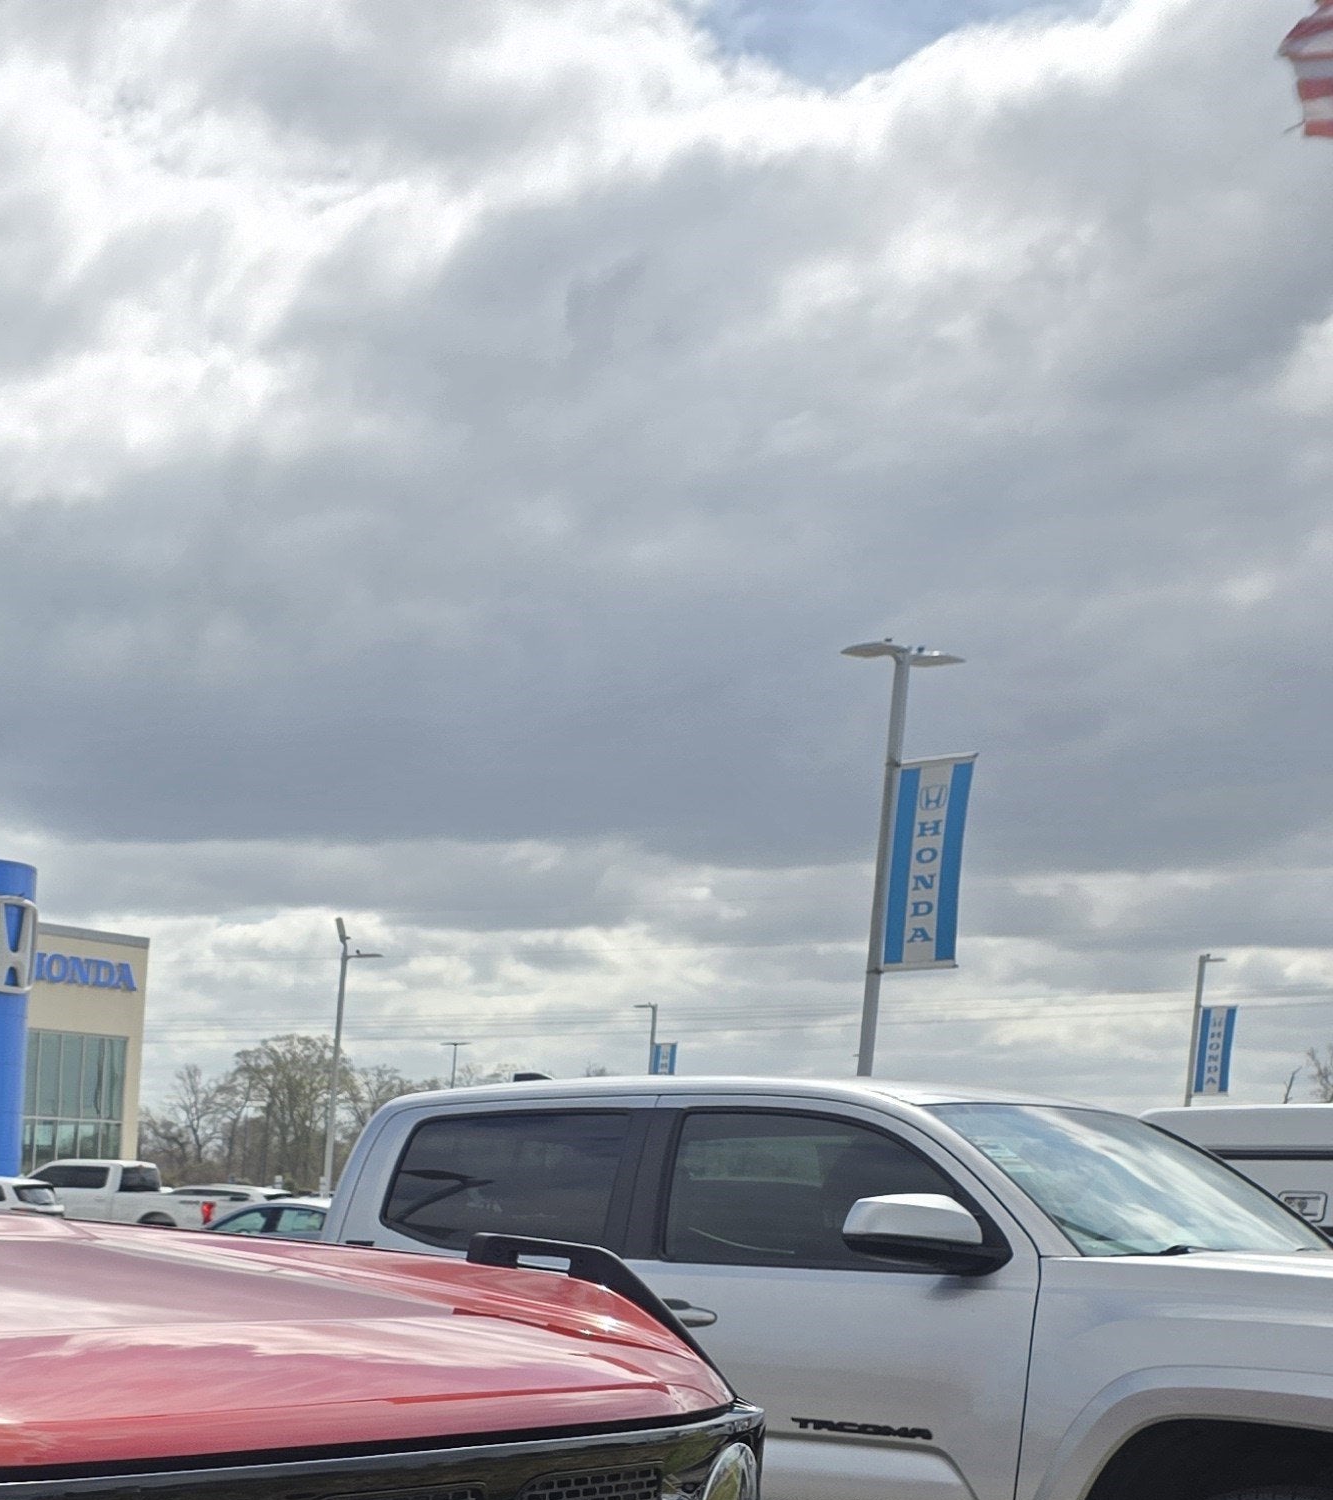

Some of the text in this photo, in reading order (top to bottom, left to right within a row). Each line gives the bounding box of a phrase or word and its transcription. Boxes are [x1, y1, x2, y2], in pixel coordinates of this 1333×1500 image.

[906, 819, 943, 943] HONDA
[1205, 1030, 1222, 1084] HONDA
[791, 1416, 933, 1440] TACOMA
